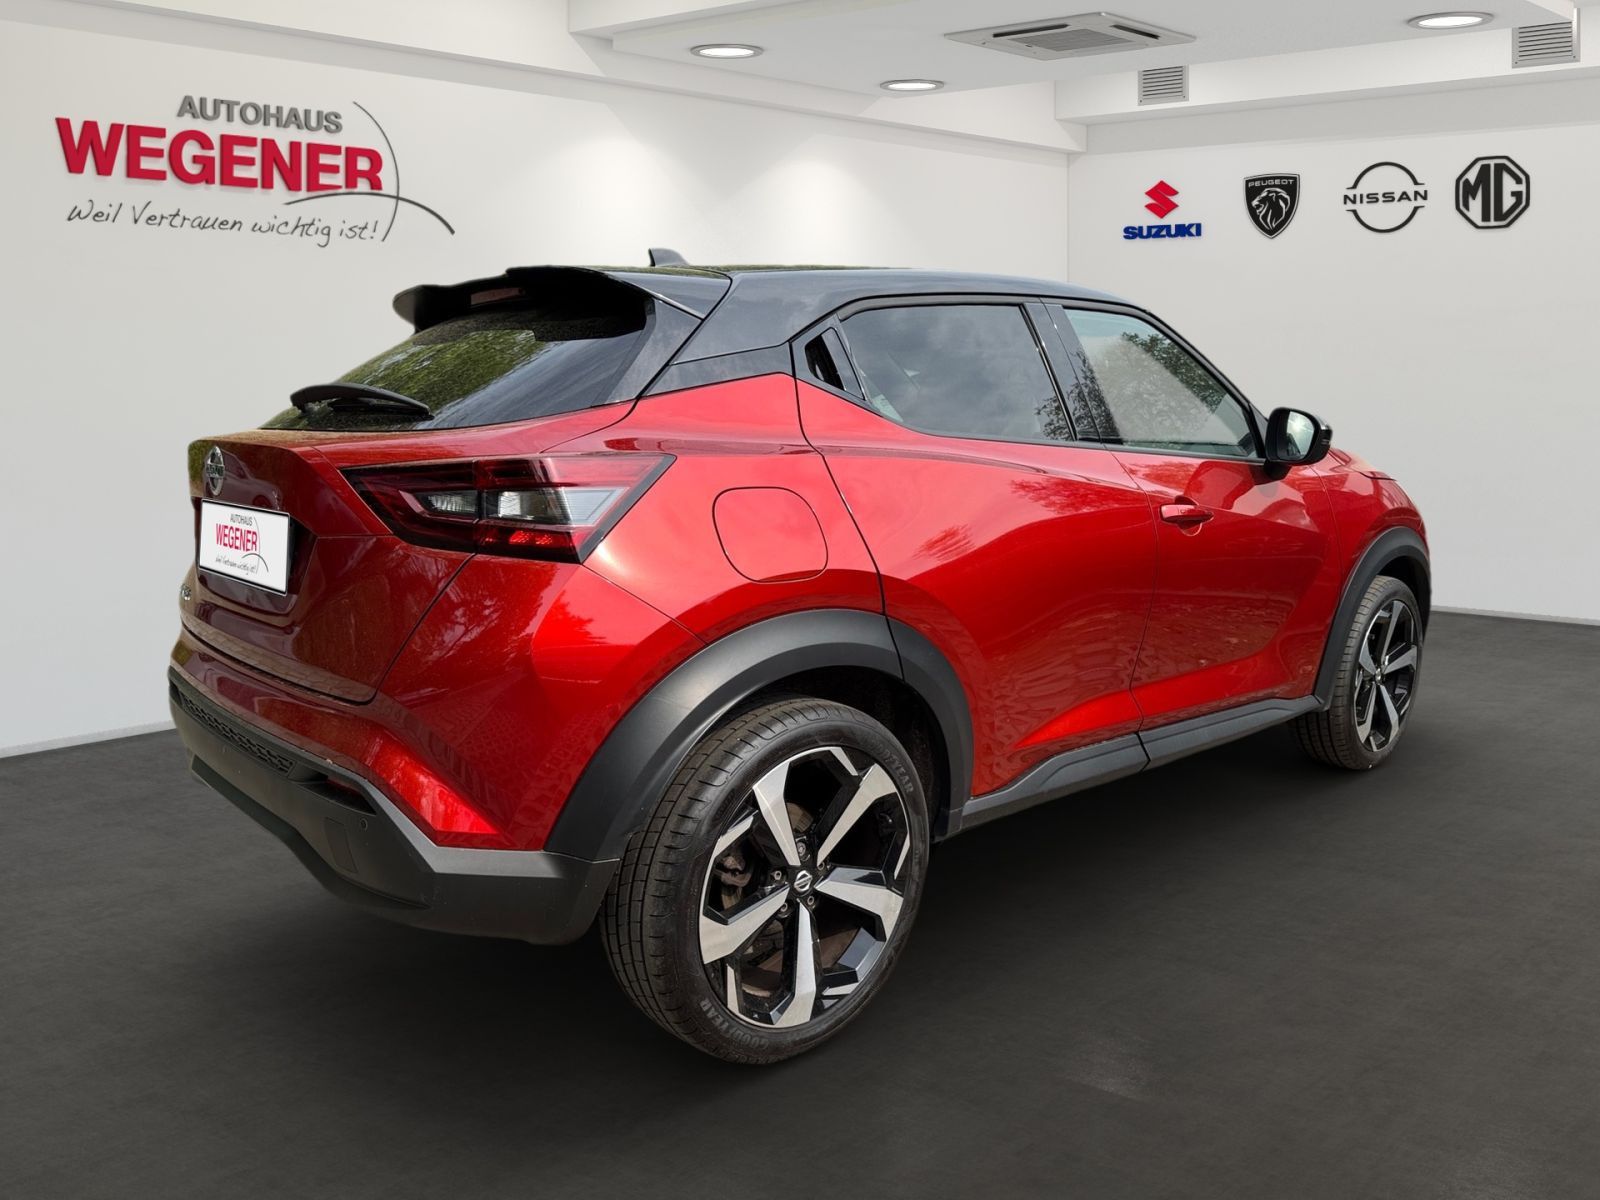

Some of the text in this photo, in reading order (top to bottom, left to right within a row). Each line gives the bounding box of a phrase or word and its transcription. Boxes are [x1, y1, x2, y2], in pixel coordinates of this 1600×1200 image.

[177, 95, 343, 133] AUTOHAUS
[55, 117, 383, 193] WEGENER
[1248, 178, 1295, 188] PEUGEOT
[1343, 189, 1429, 206] NISSAN
[1462, 163, 1524, 222] MG
[67, 200, 380, 248] Weil Vertrauen wichtig ist!
[1123, 222, 1202, 240] SUZUKI
[230, 513, 253, 527] AUTOHAUS
[216, 523, 258, 552] WEGENER
